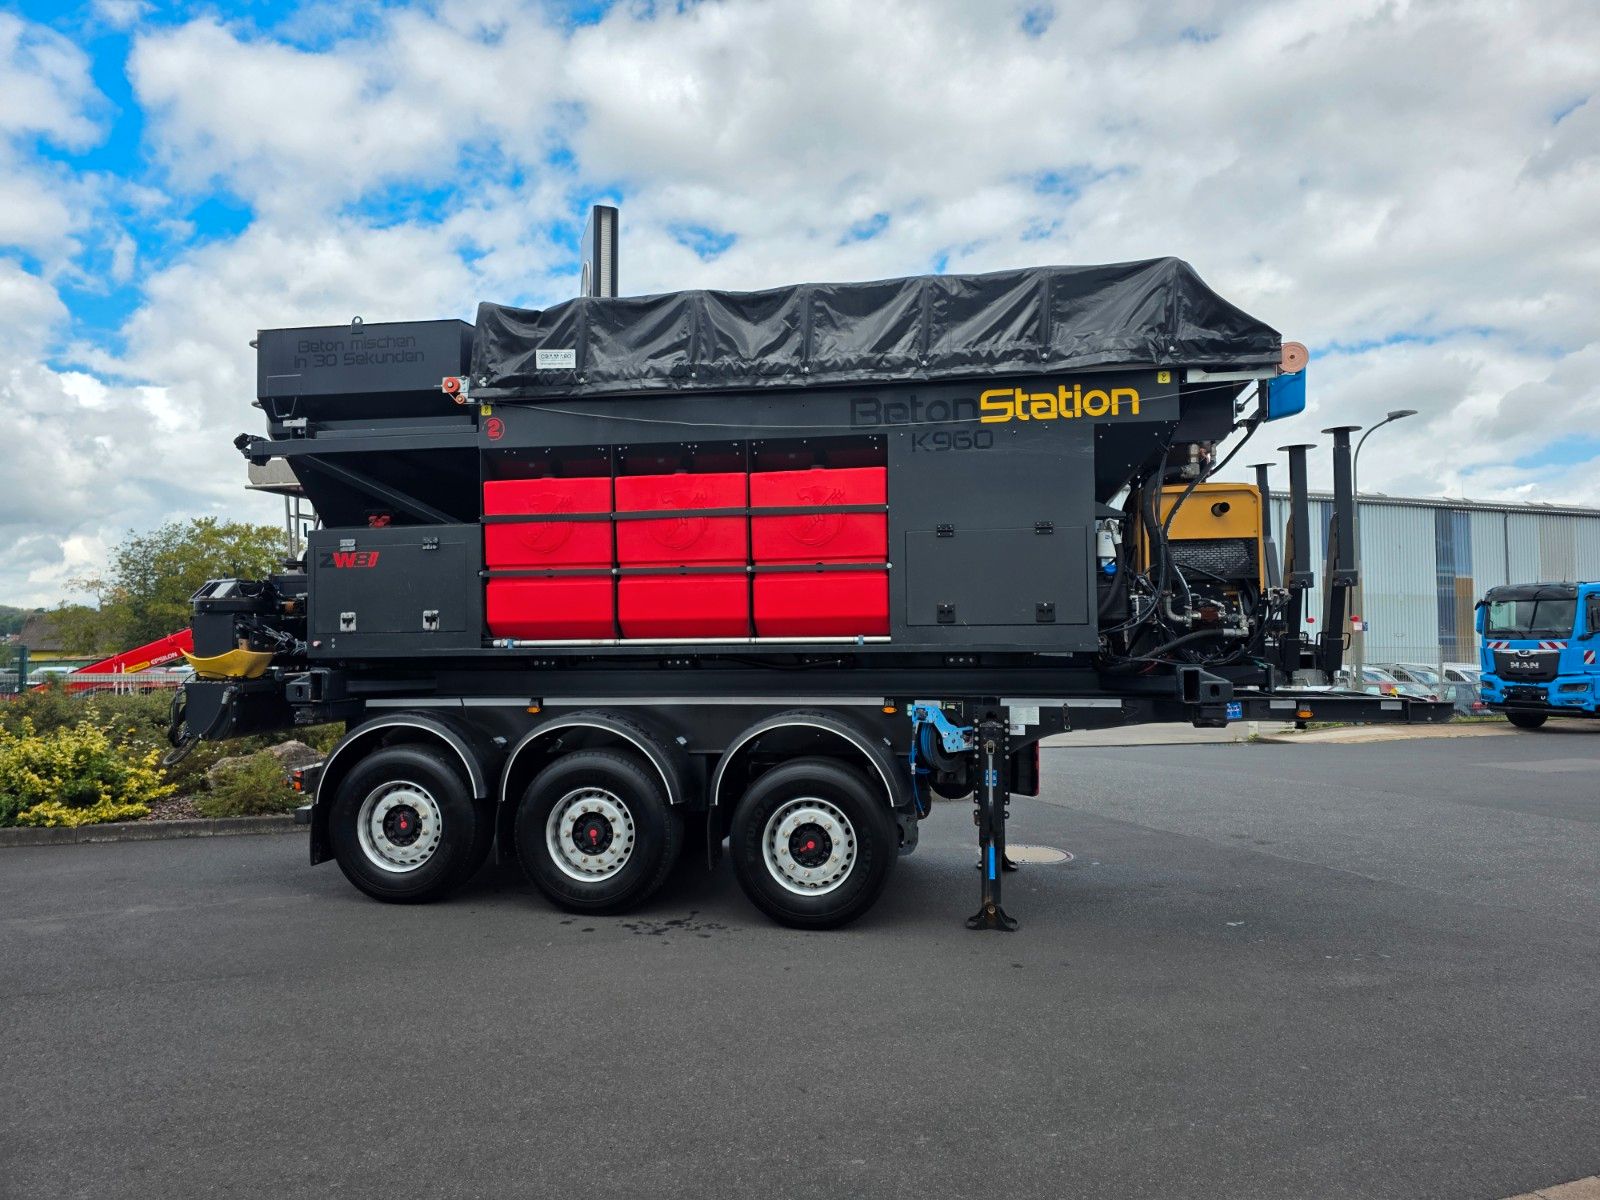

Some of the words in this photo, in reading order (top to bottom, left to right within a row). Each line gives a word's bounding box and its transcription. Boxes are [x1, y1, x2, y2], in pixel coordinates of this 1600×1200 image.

[298, 340, 344, 353] Beton
[351, 336, 415, 350] mischen
[313, 353, 338, 368] 30
[344, 351, 425, 366] Sekunden
[487, 420, 500, 437] 2
[912, 429, 993, 453] K960
[1510, 661, 1540, 669] MAN
